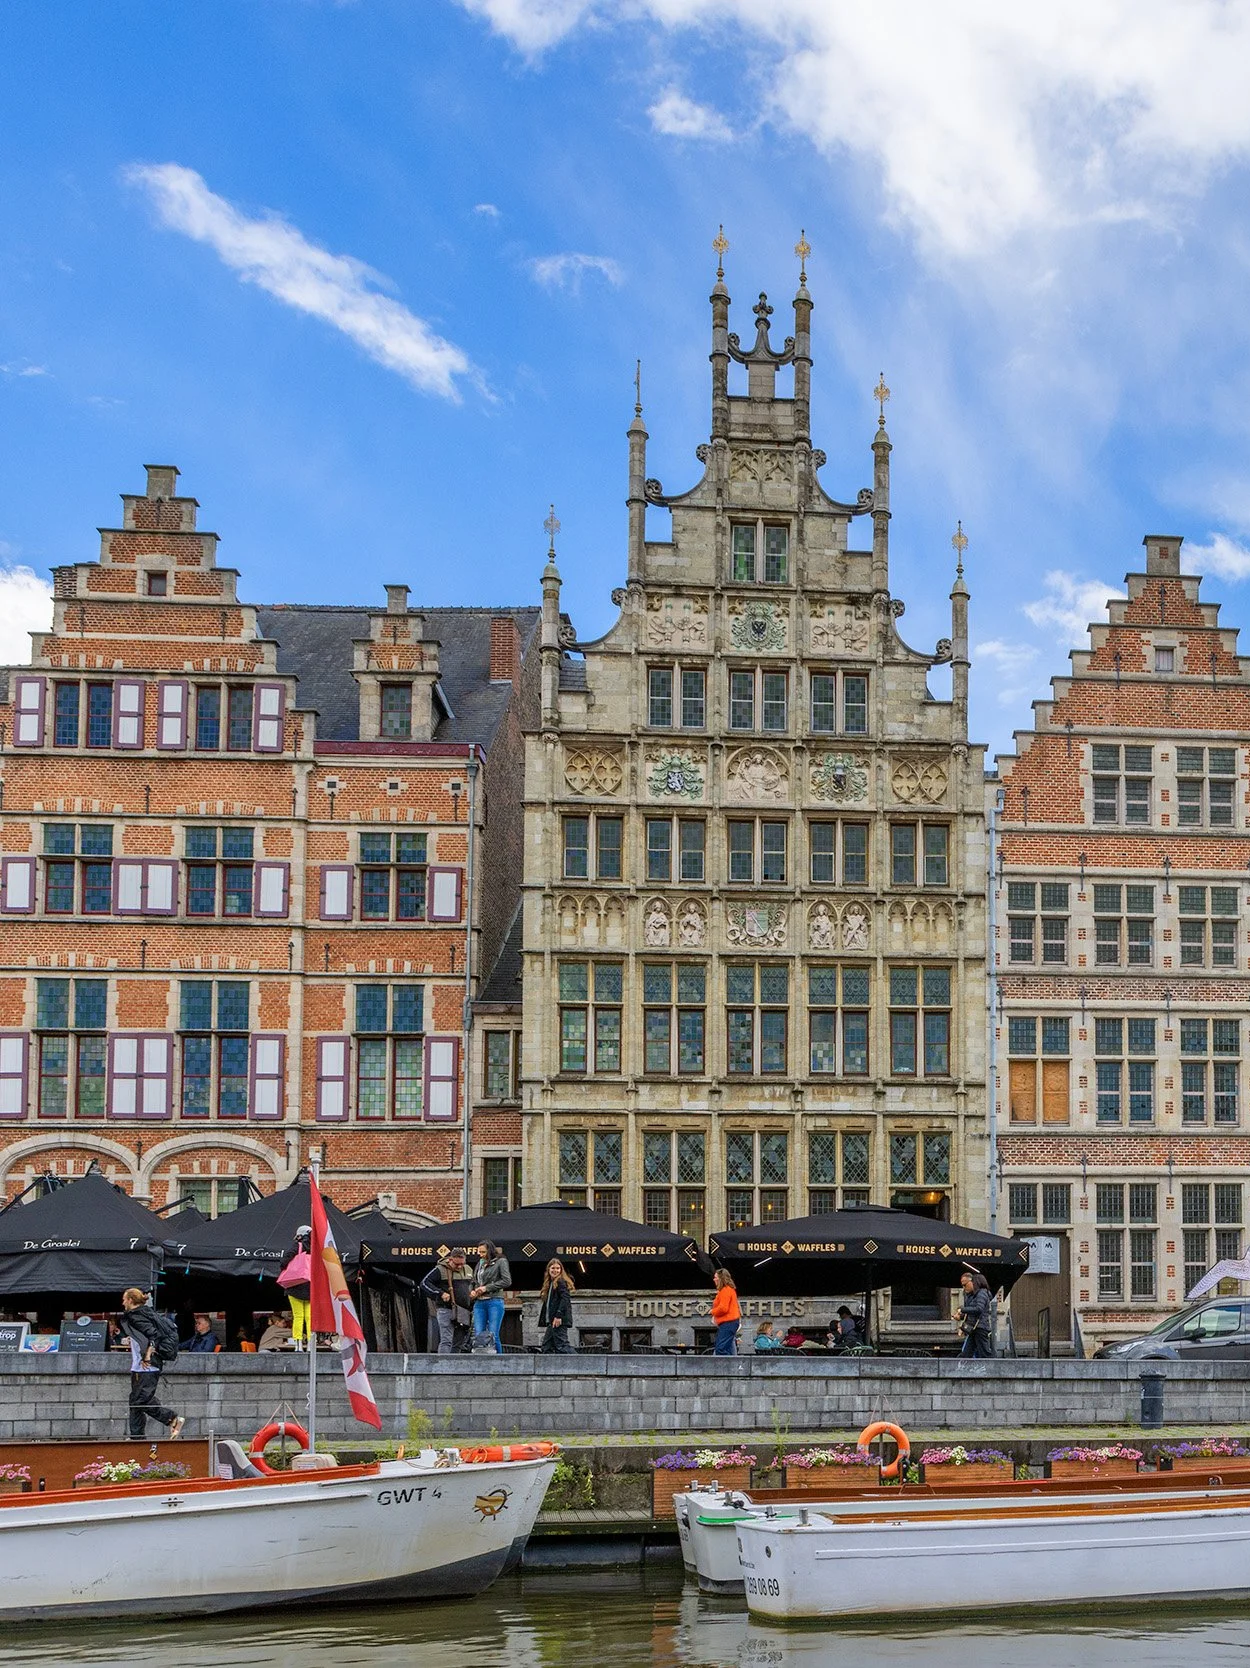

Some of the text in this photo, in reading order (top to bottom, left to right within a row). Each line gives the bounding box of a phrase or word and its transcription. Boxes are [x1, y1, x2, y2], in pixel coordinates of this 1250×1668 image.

[23, 1241, 39, 1249] De
[129, 1238, 139, 1249] 7
[747, 1243, 778, 1252] HOUSE
[797, 1243, 836, 1252] WAFFLES
[177, 1244, 187, 1255] 7
[235, 1248, 285, 1258] De Grasl
[400, 1247, 433, 1256] HOUSE
[565, 1246, 597, 1255] HOUSE
[617, 1246, 657, 1255] WAFFLES
[905, 1245, 936, 1255] HOUSE
[954, 1247, 993, 1257] WAFFLES
[625, 1300, 693, 1318] HOUSE
[739, 1300, 806, 1317] FFLES
[377, 1486, 443, 1506] GWT 4
[767, 1578, 780, 1597] 69
